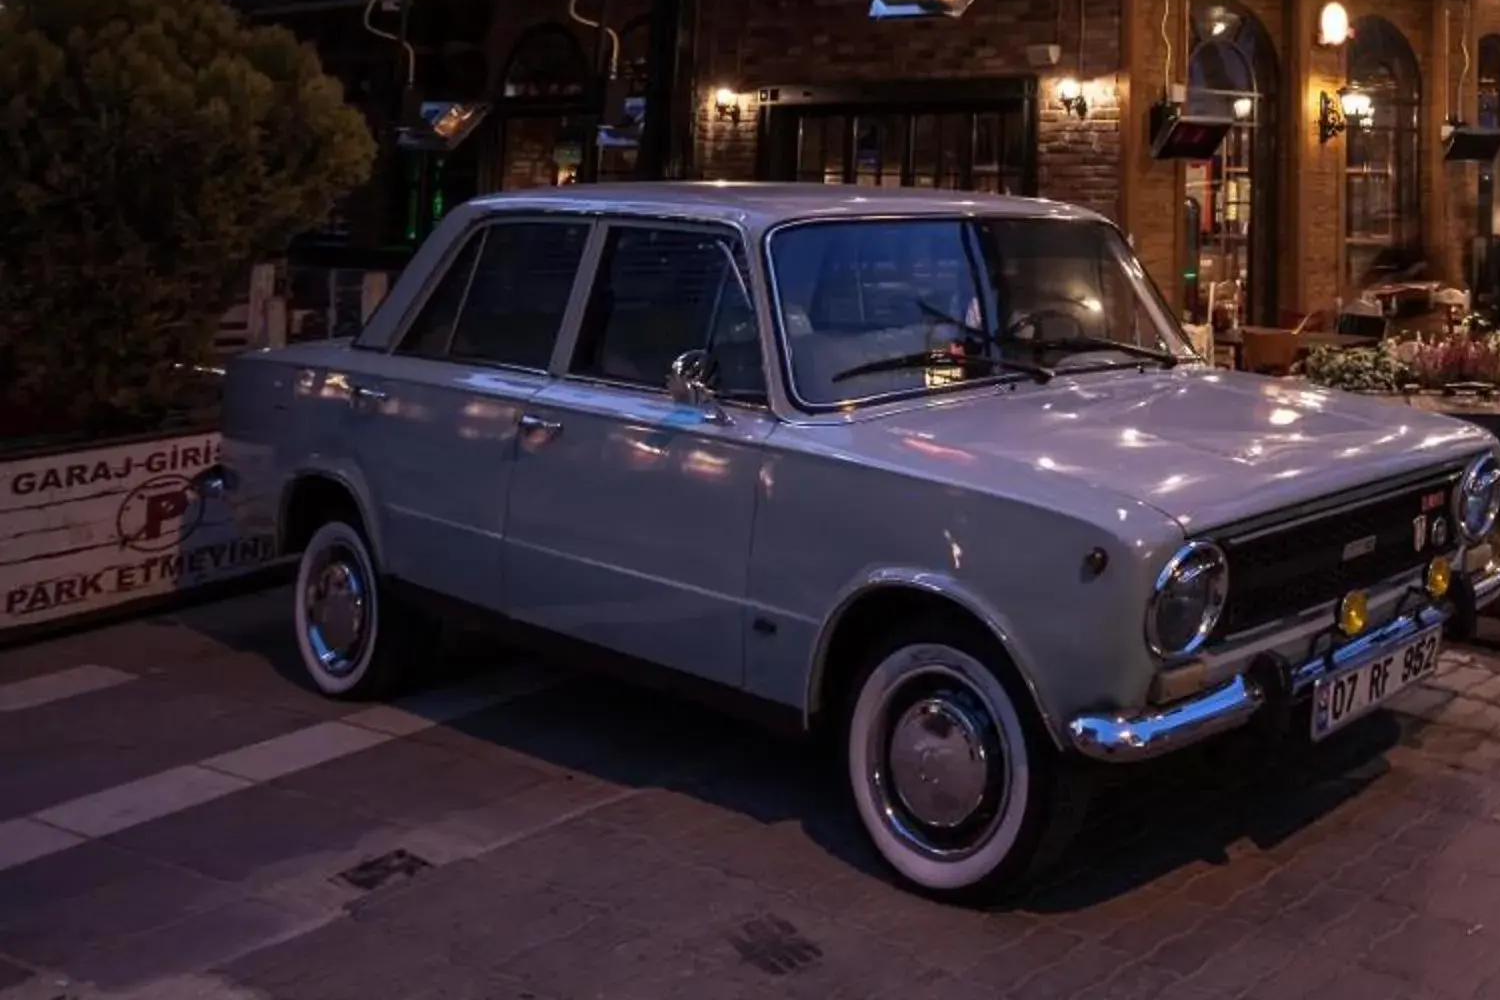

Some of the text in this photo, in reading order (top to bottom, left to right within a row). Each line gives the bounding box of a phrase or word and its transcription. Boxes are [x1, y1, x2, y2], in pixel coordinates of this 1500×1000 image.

[5, 571, 104, 614] PARK
[1332, 673, 1358, 720] 07
[1369, 656, 1394, 703] RF
